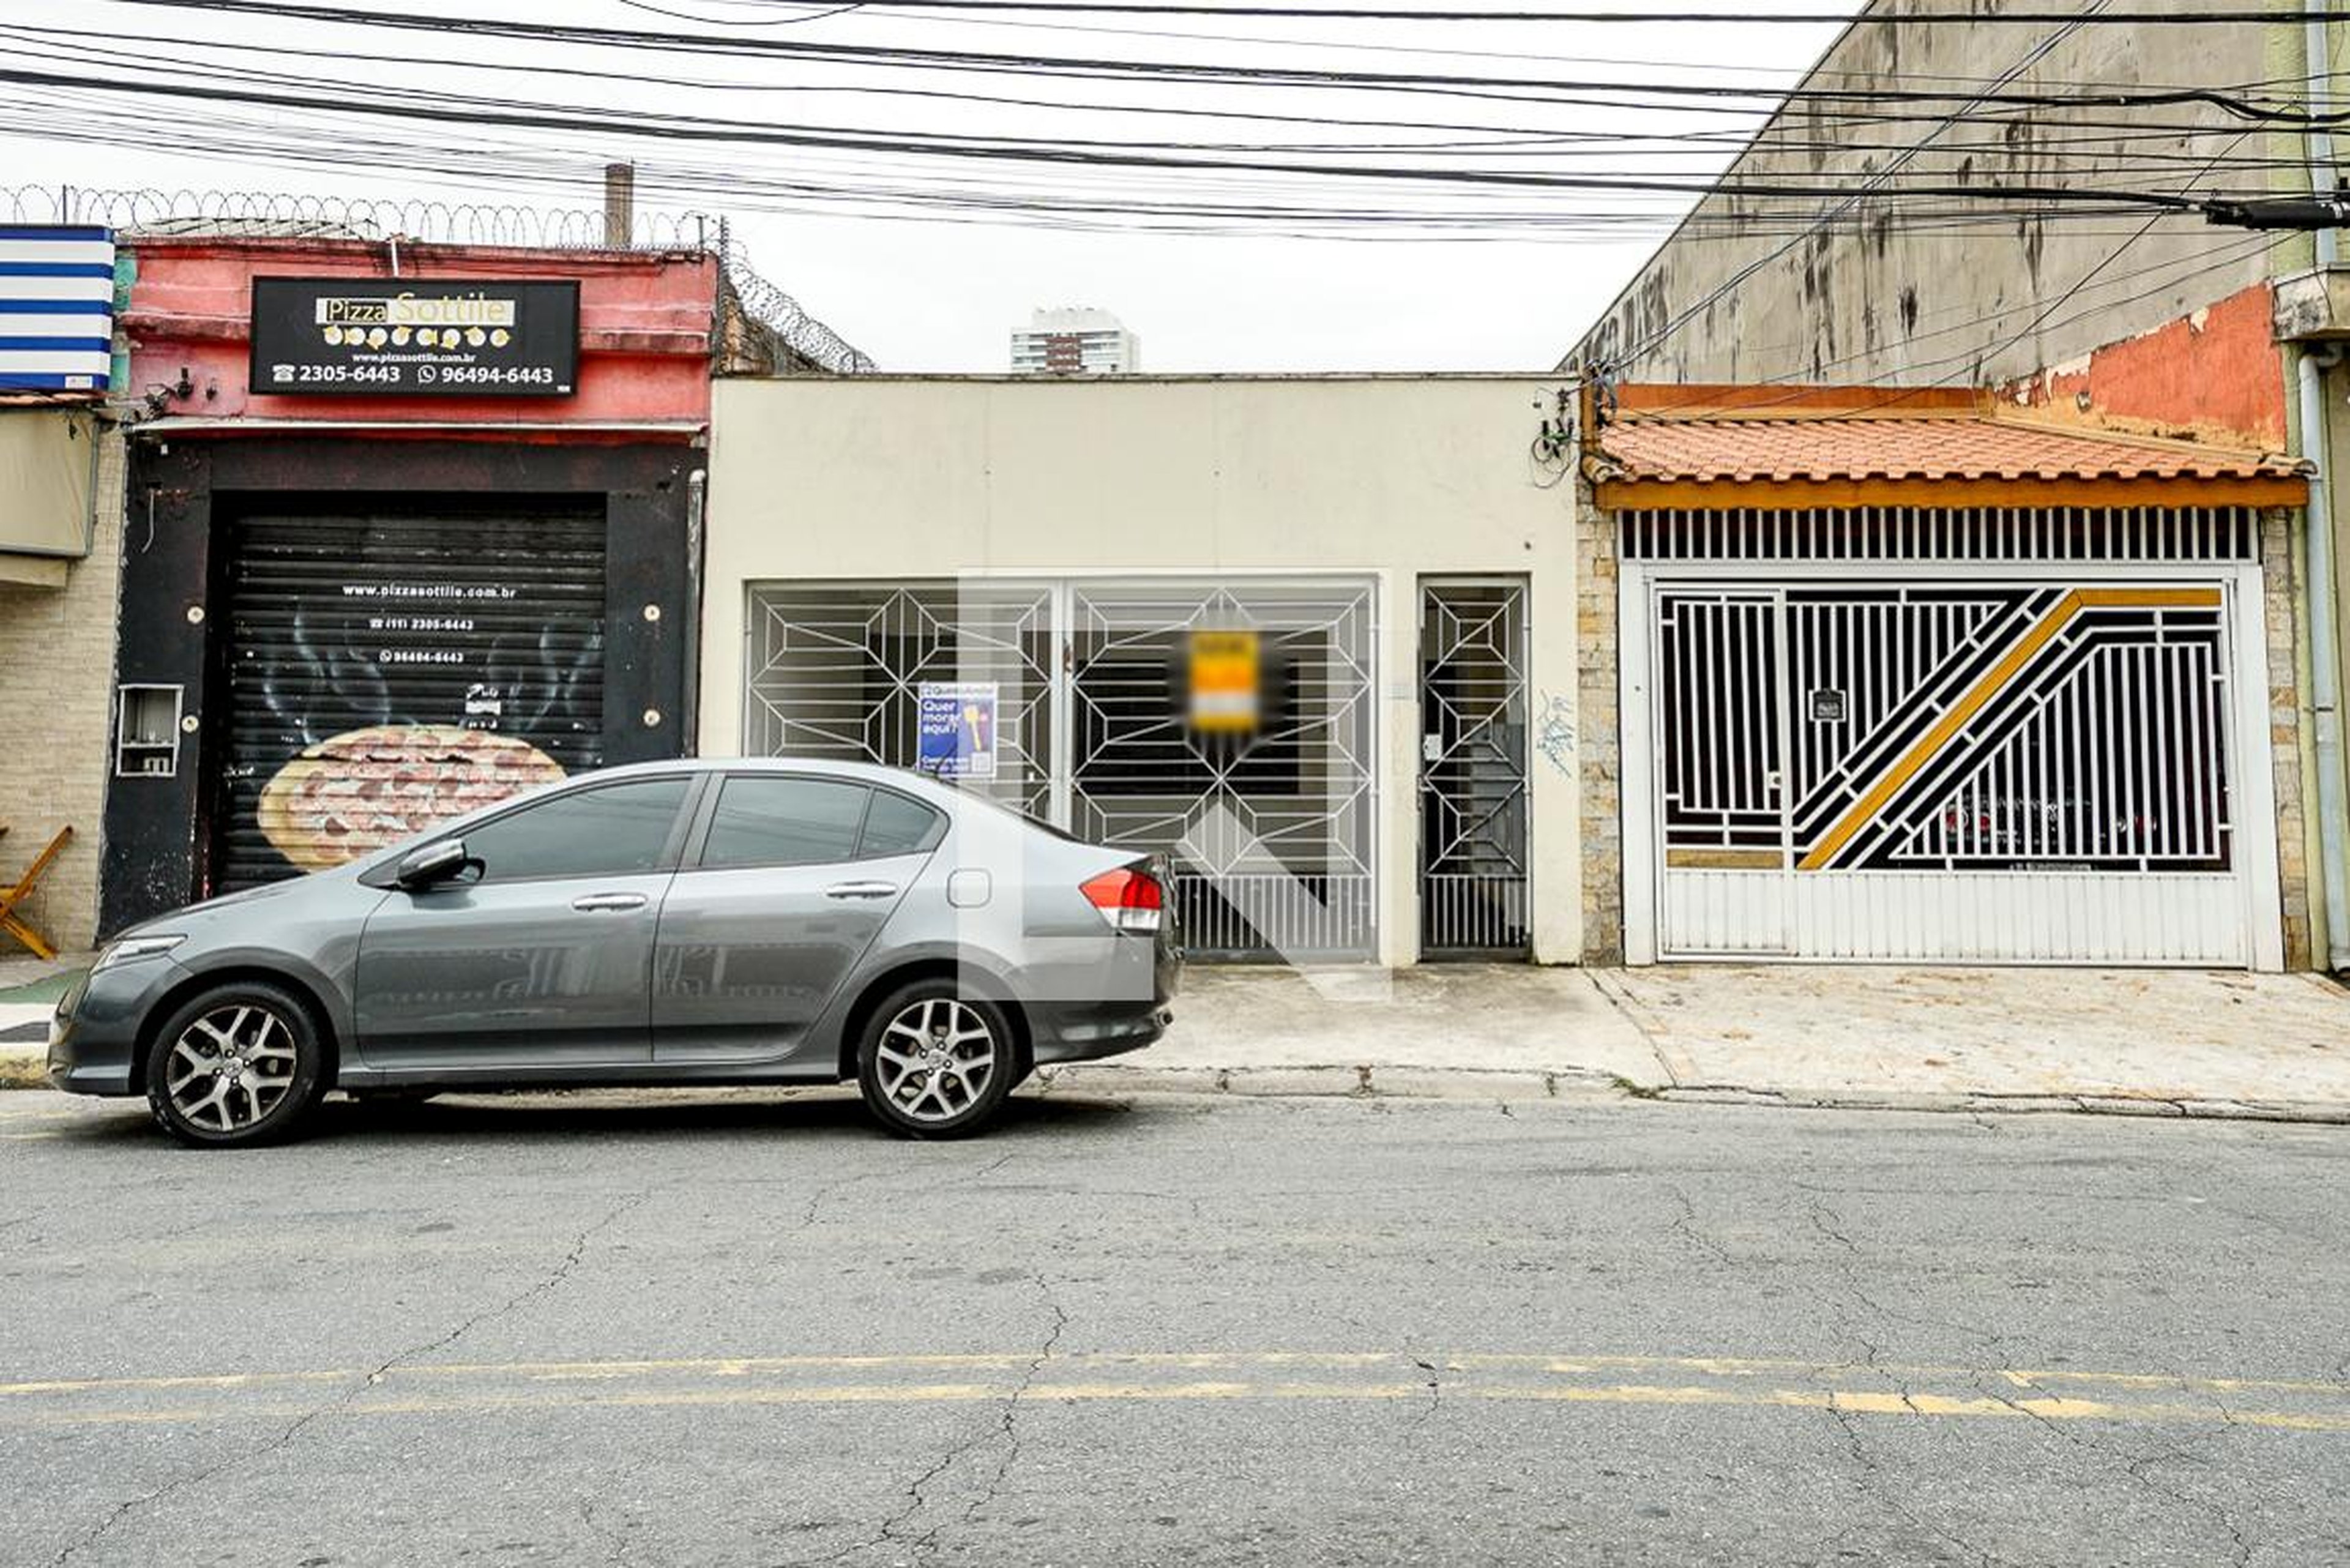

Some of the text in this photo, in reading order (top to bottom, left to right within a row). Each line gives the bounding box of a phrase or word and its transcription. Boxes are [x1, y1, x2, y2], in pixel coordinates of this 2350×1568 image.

[329, 291, 505, 322] Pizza Sottile
[352, 353, 476, 363] www.pizzasottile.com.br
[299, 365, 553, 384] 2305-6443 96494-6443
[343, 583, 517, 599] www.pizzasottile.com.br
[411, 618, 474, 630] 2305-6443
[394, 651, 464, 663] 96494-6443
[923, 701, 956, 712] Quer
